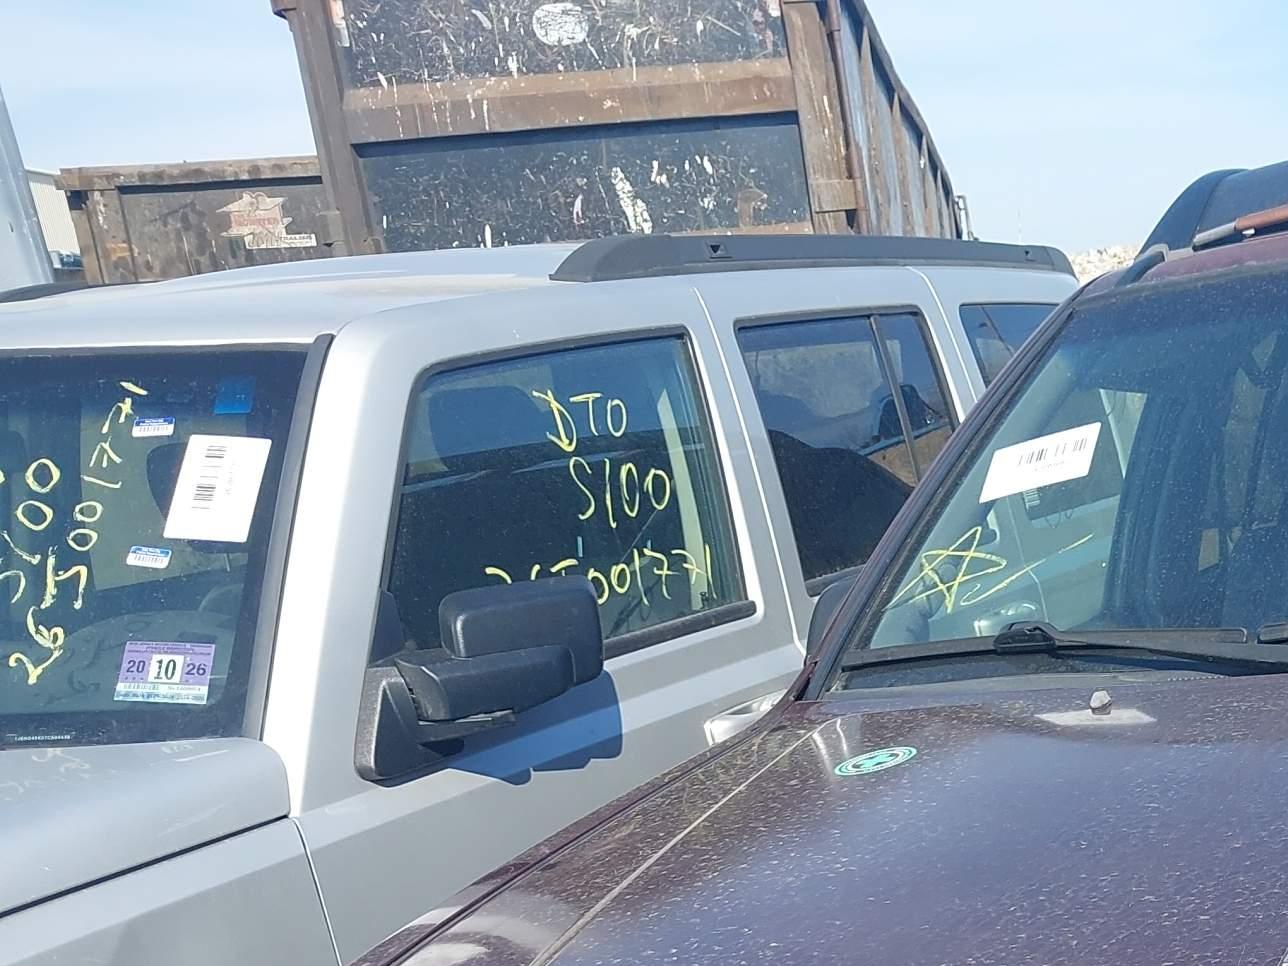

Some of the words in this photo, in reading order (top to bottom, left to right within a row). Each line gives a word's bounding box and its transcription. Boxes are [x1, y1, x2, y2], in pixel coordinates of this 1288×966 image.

[568, 456, 671, 529] S100
[484, 543, 718, 607] 001771
[126, 659, 147, 674] 20
[153, 658, 177, 681] 10
[185, 662, 208, 677] 26
